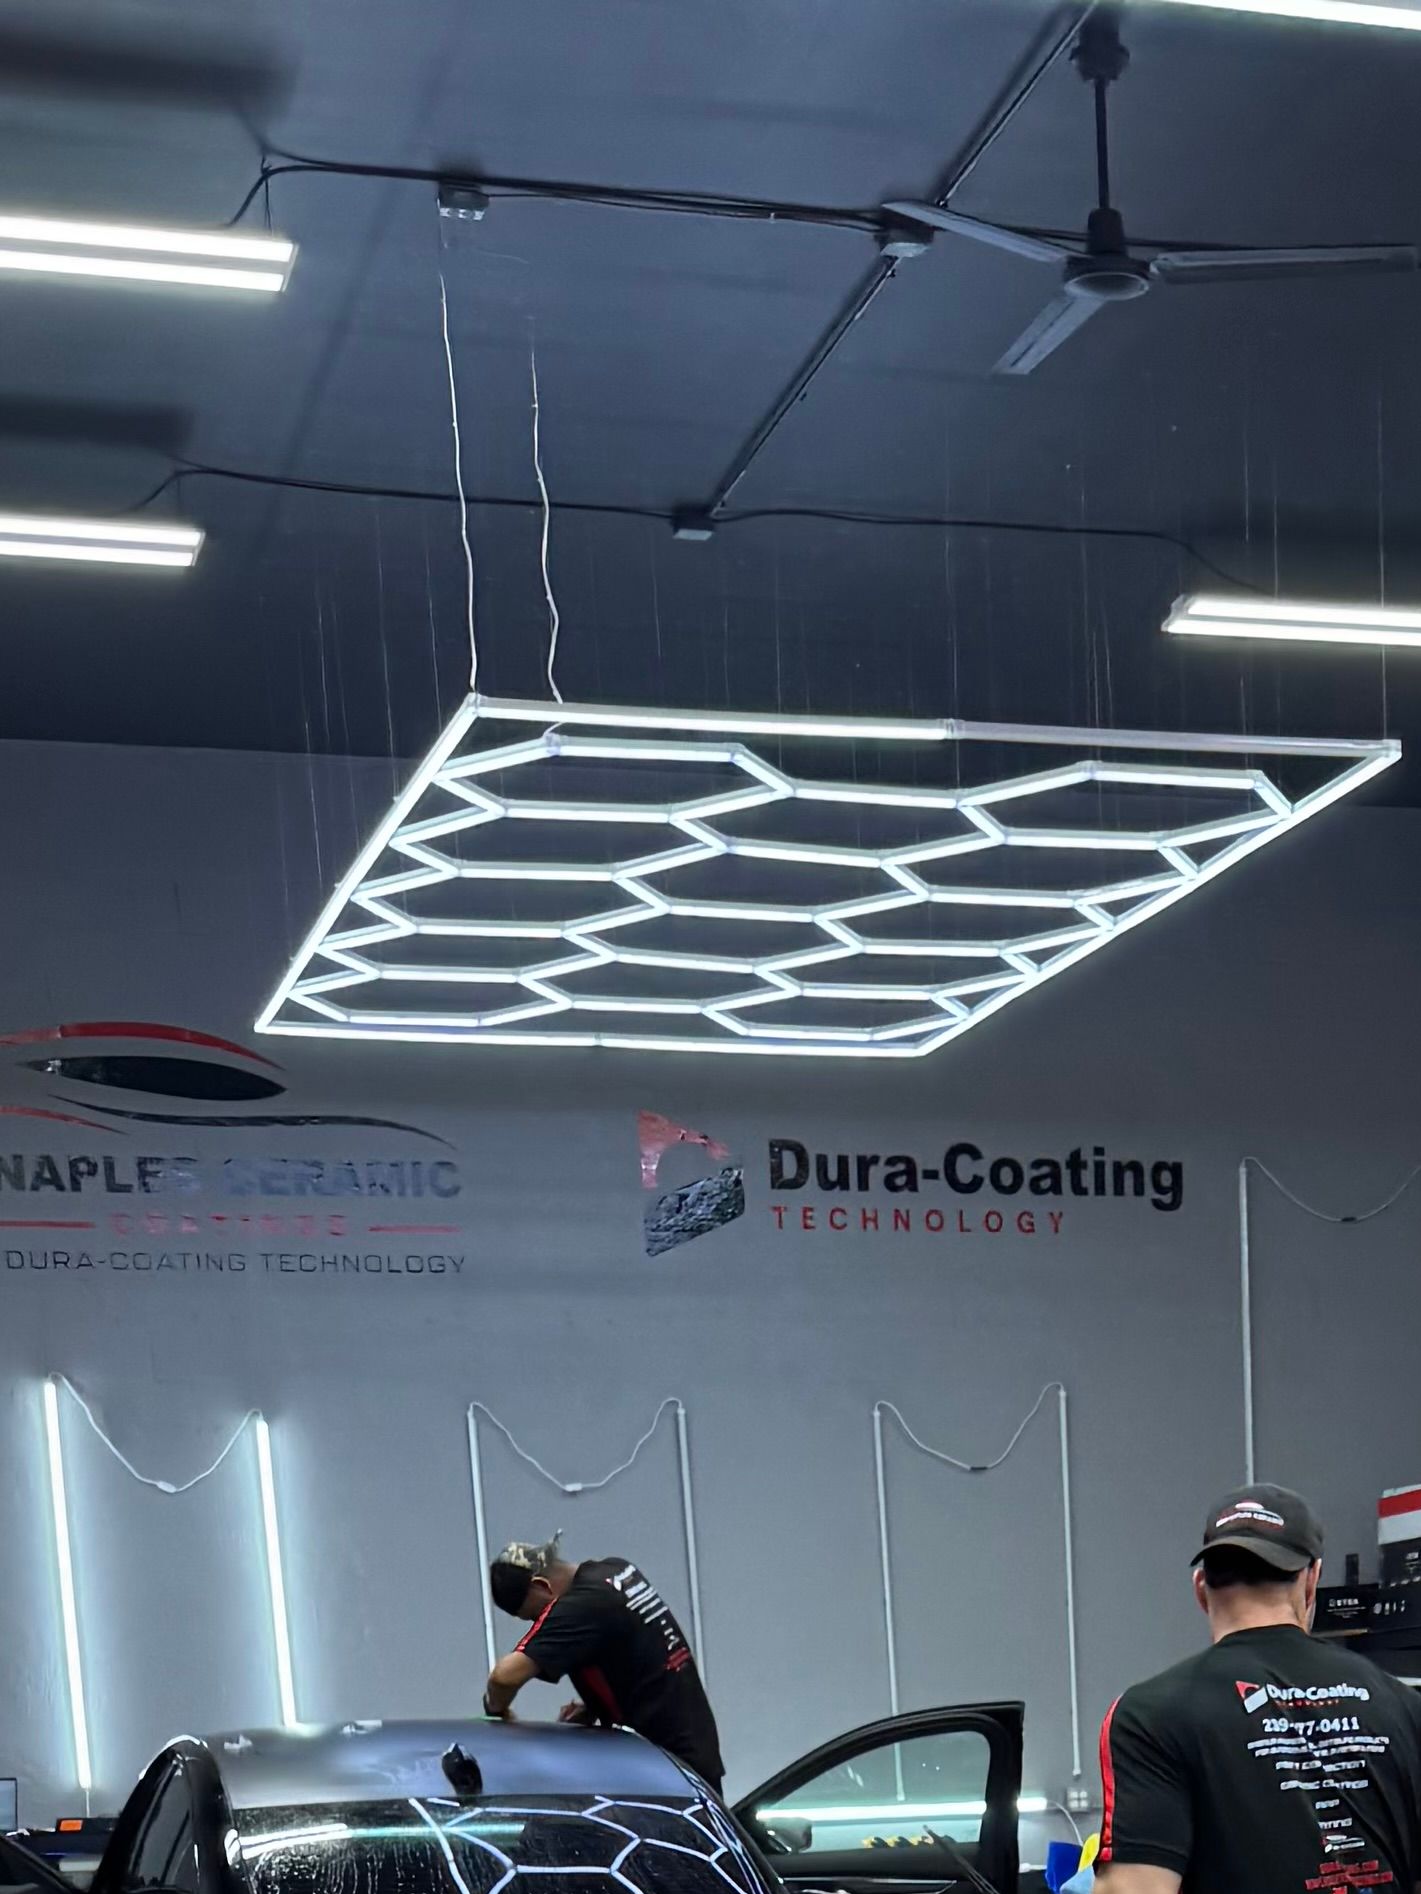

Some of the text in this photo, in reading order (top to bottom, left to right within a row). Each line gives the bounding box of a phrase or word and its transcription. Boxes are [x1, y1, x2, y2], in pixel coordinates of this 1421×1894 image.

[768, 1139, 1183, 1212] Dura-Coating
[770, 1205, 1064, 1235] TECHNOLOGY
[6, 1250, 465, 1274] DURA-COATING TECHNOLOGY
